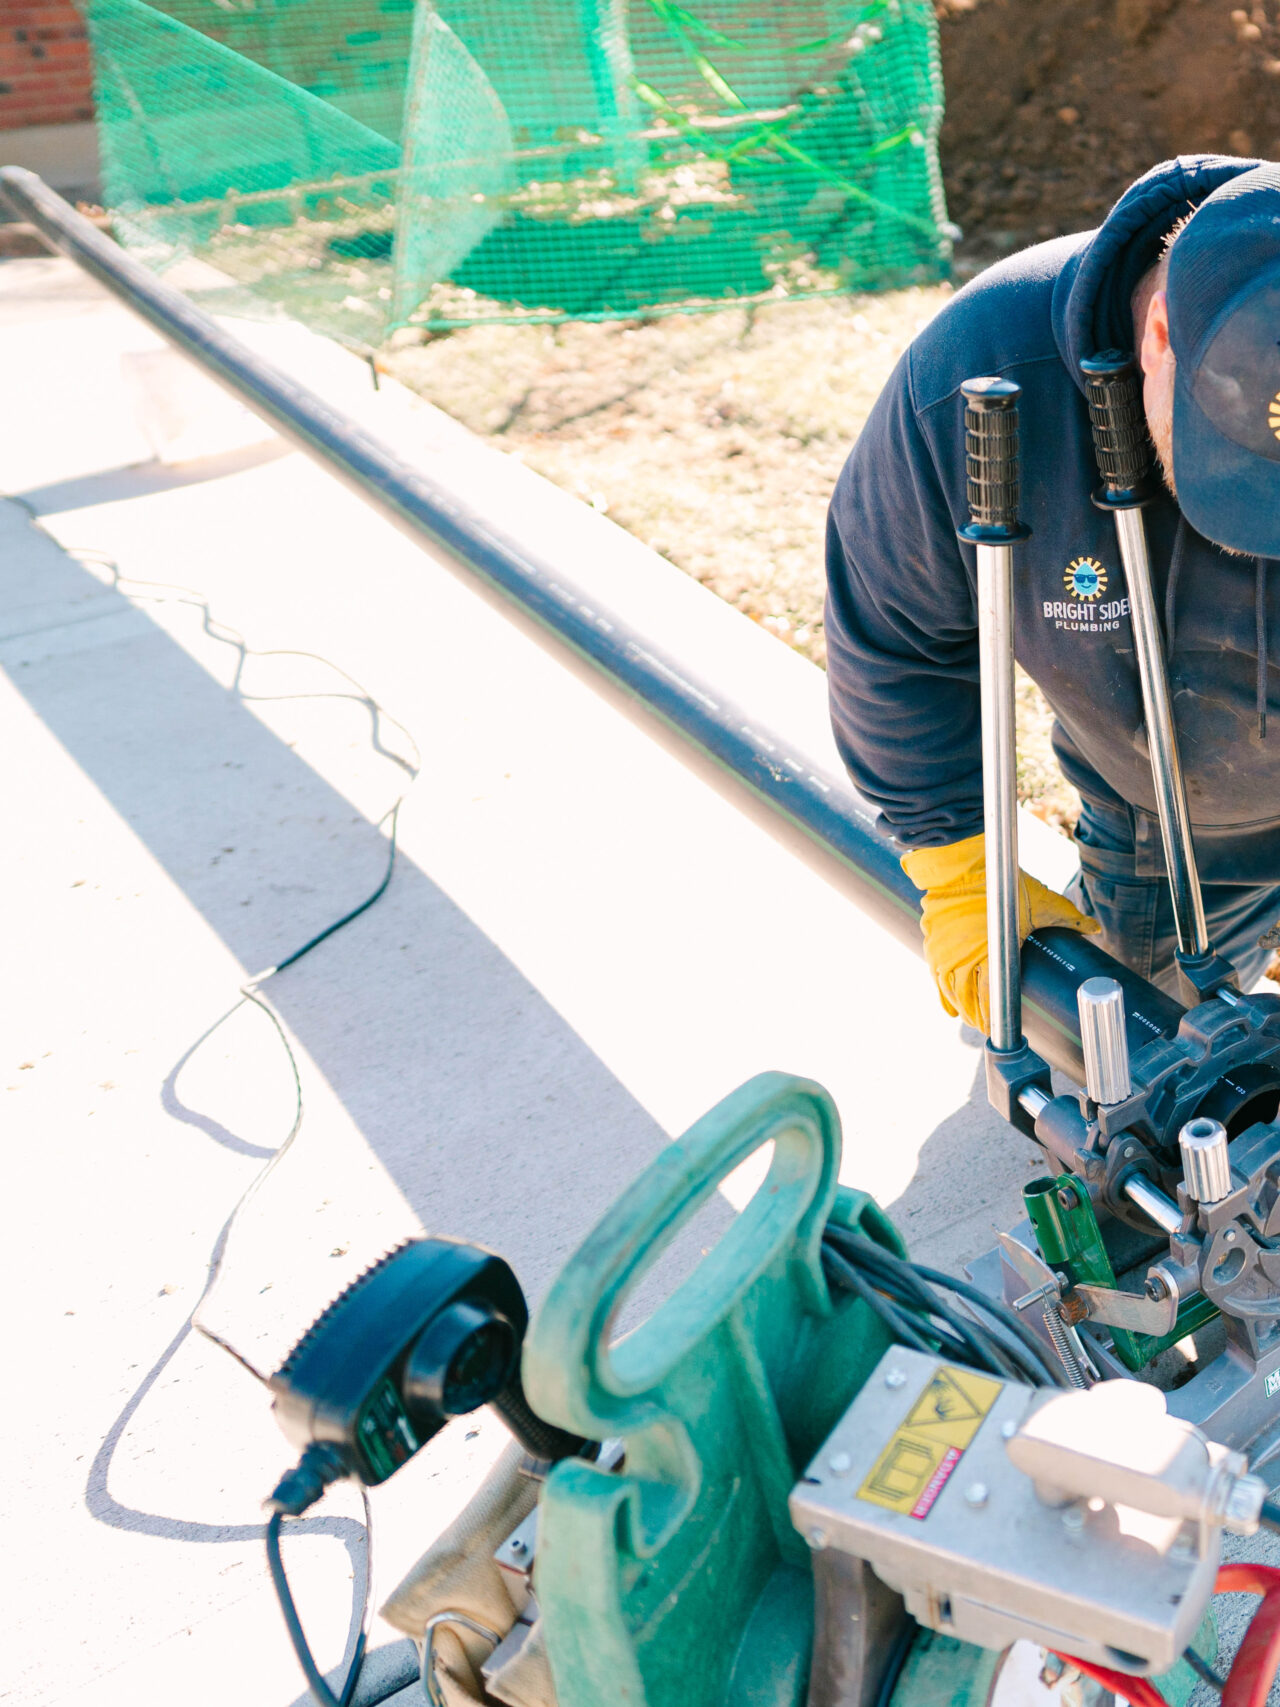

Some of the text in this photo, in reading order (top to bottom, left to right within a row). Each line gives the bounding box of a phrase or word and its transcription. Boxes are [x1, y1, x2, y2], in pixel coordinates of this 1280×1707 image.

[1043, 598, 1129, 621] BRIGHT SIDE
[1055, 620, 1120, 632] PLUMBING
